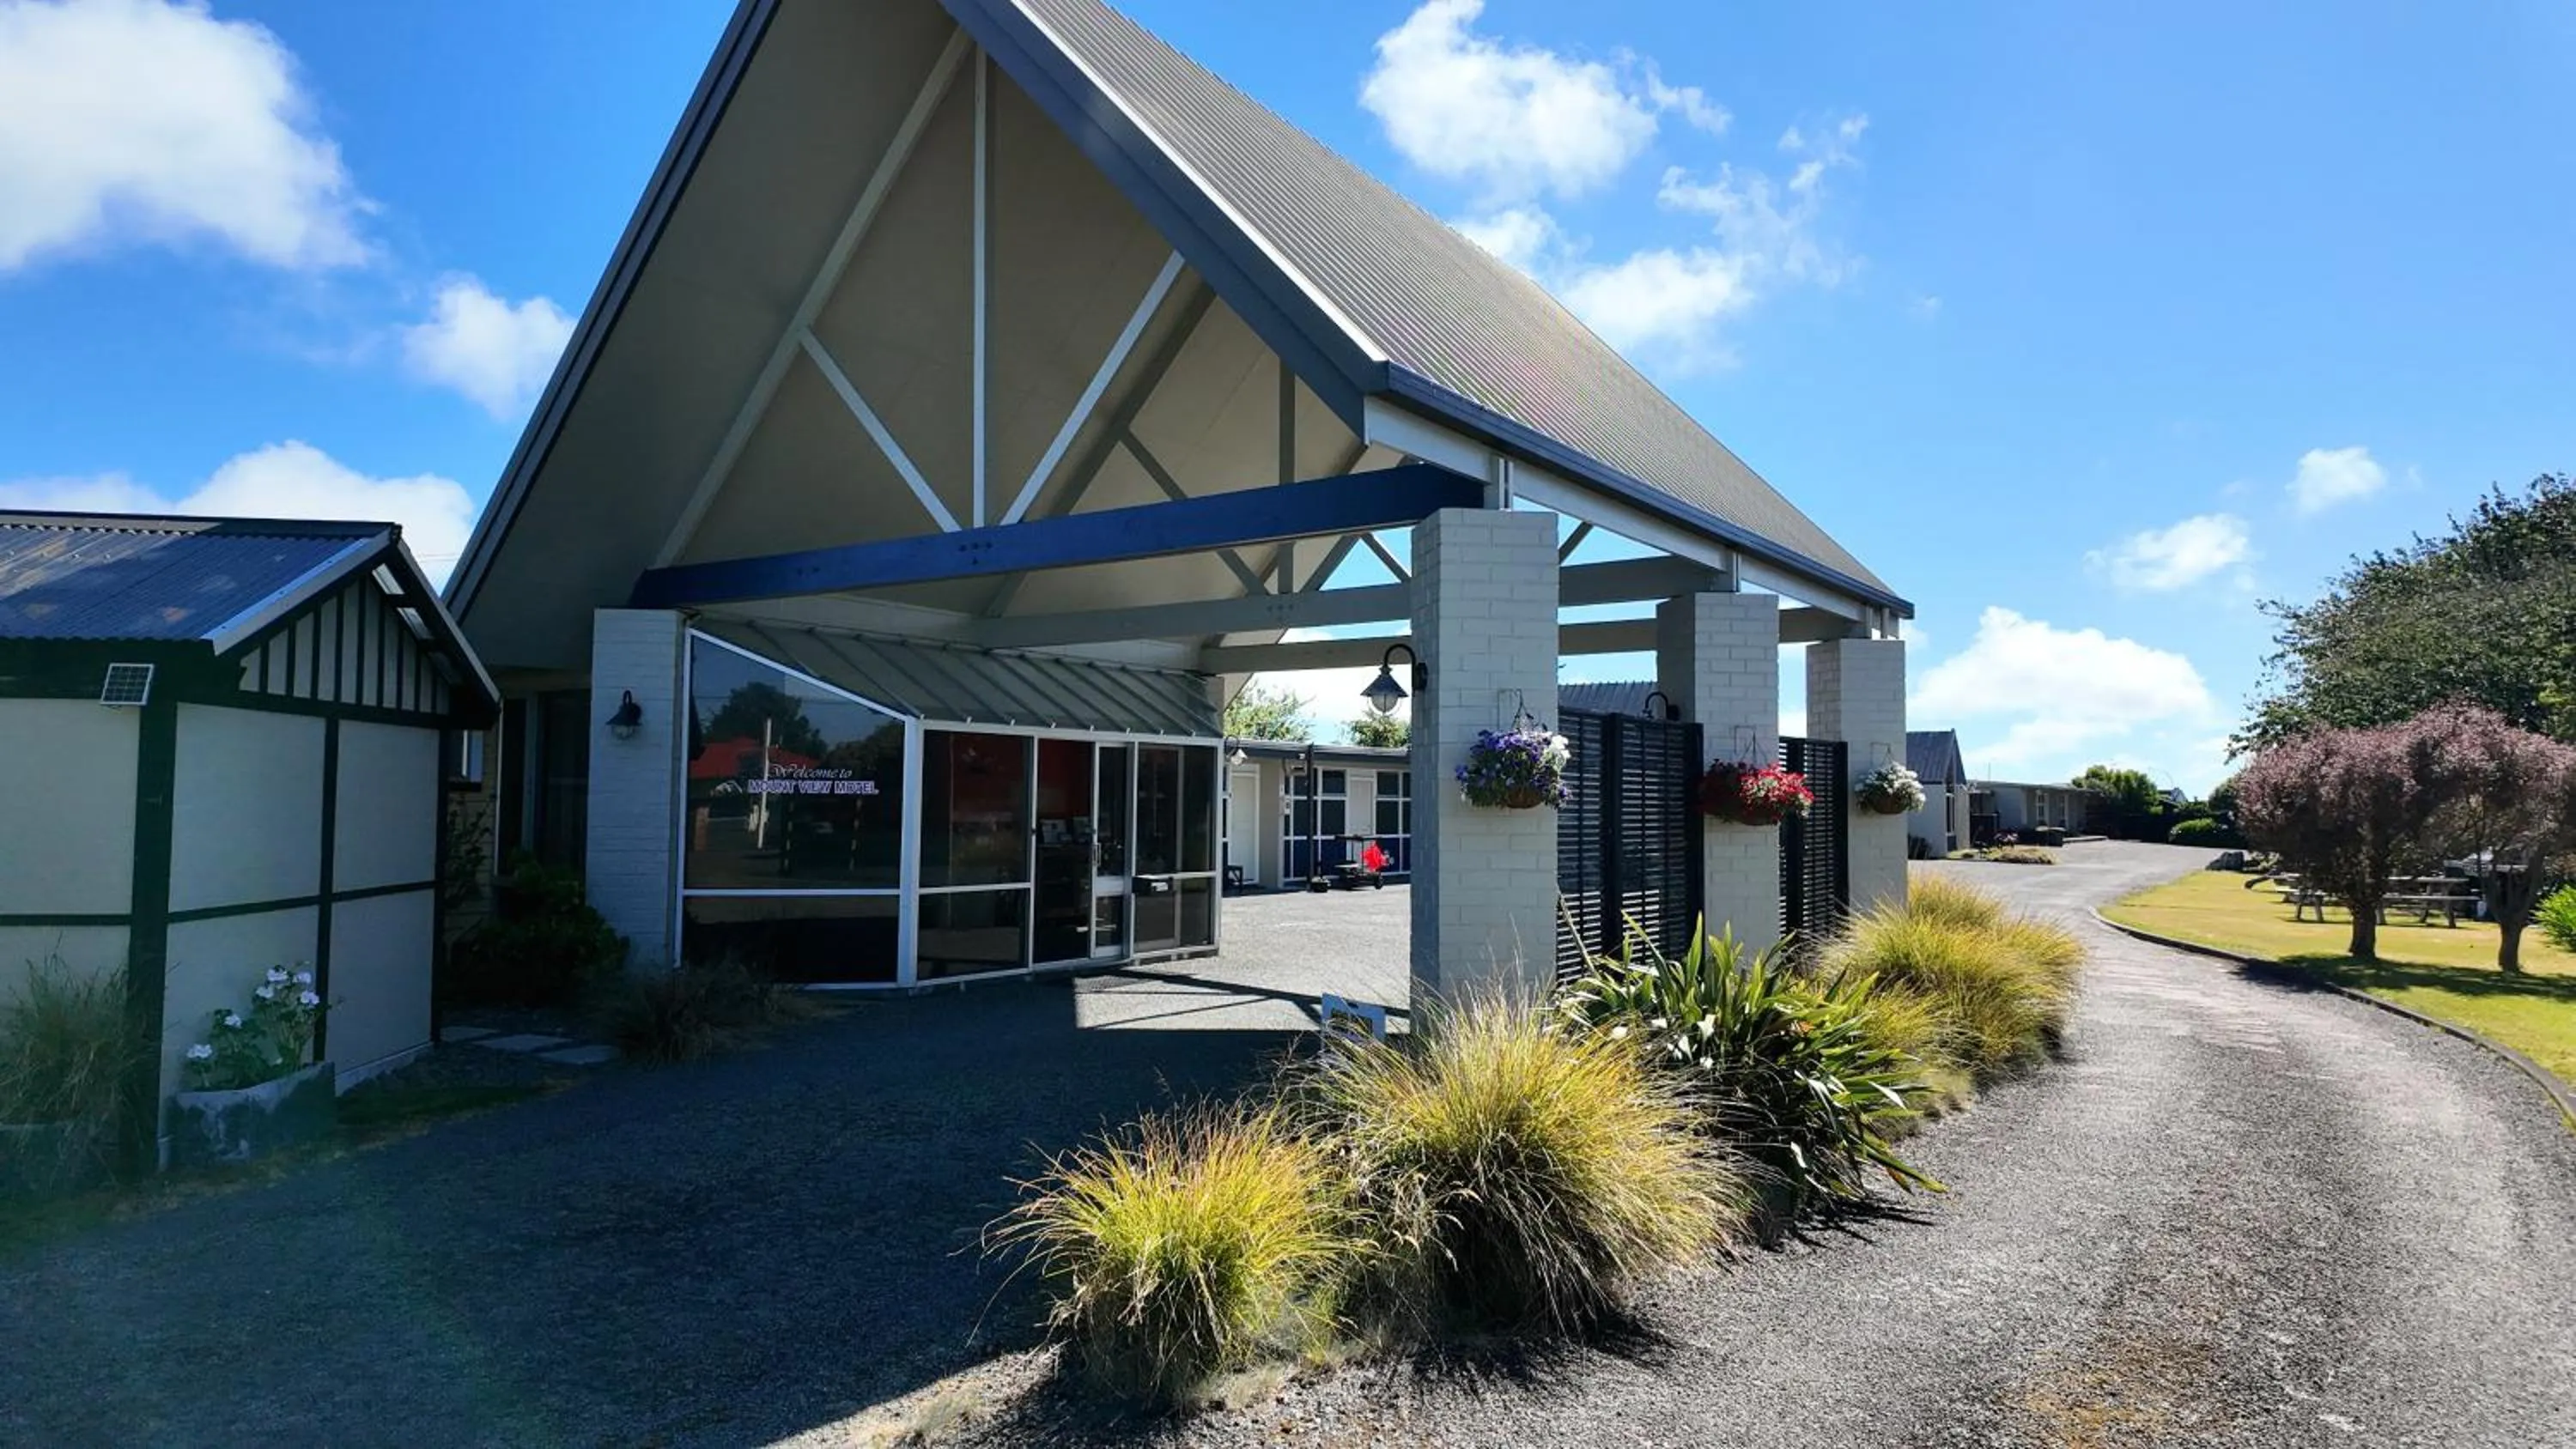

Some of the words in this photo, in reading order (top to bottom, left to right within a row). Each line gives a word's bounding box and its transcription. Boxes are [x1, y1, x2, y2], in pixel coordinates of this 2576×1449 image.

[771, 763, 838, 779] Welcome
[839, 768, 853, 779] to
[748, 779, 795, 794] MOUNT
[798, 779, 833, 794] VIEW
[834, 780, 879, 795] MOTEL
